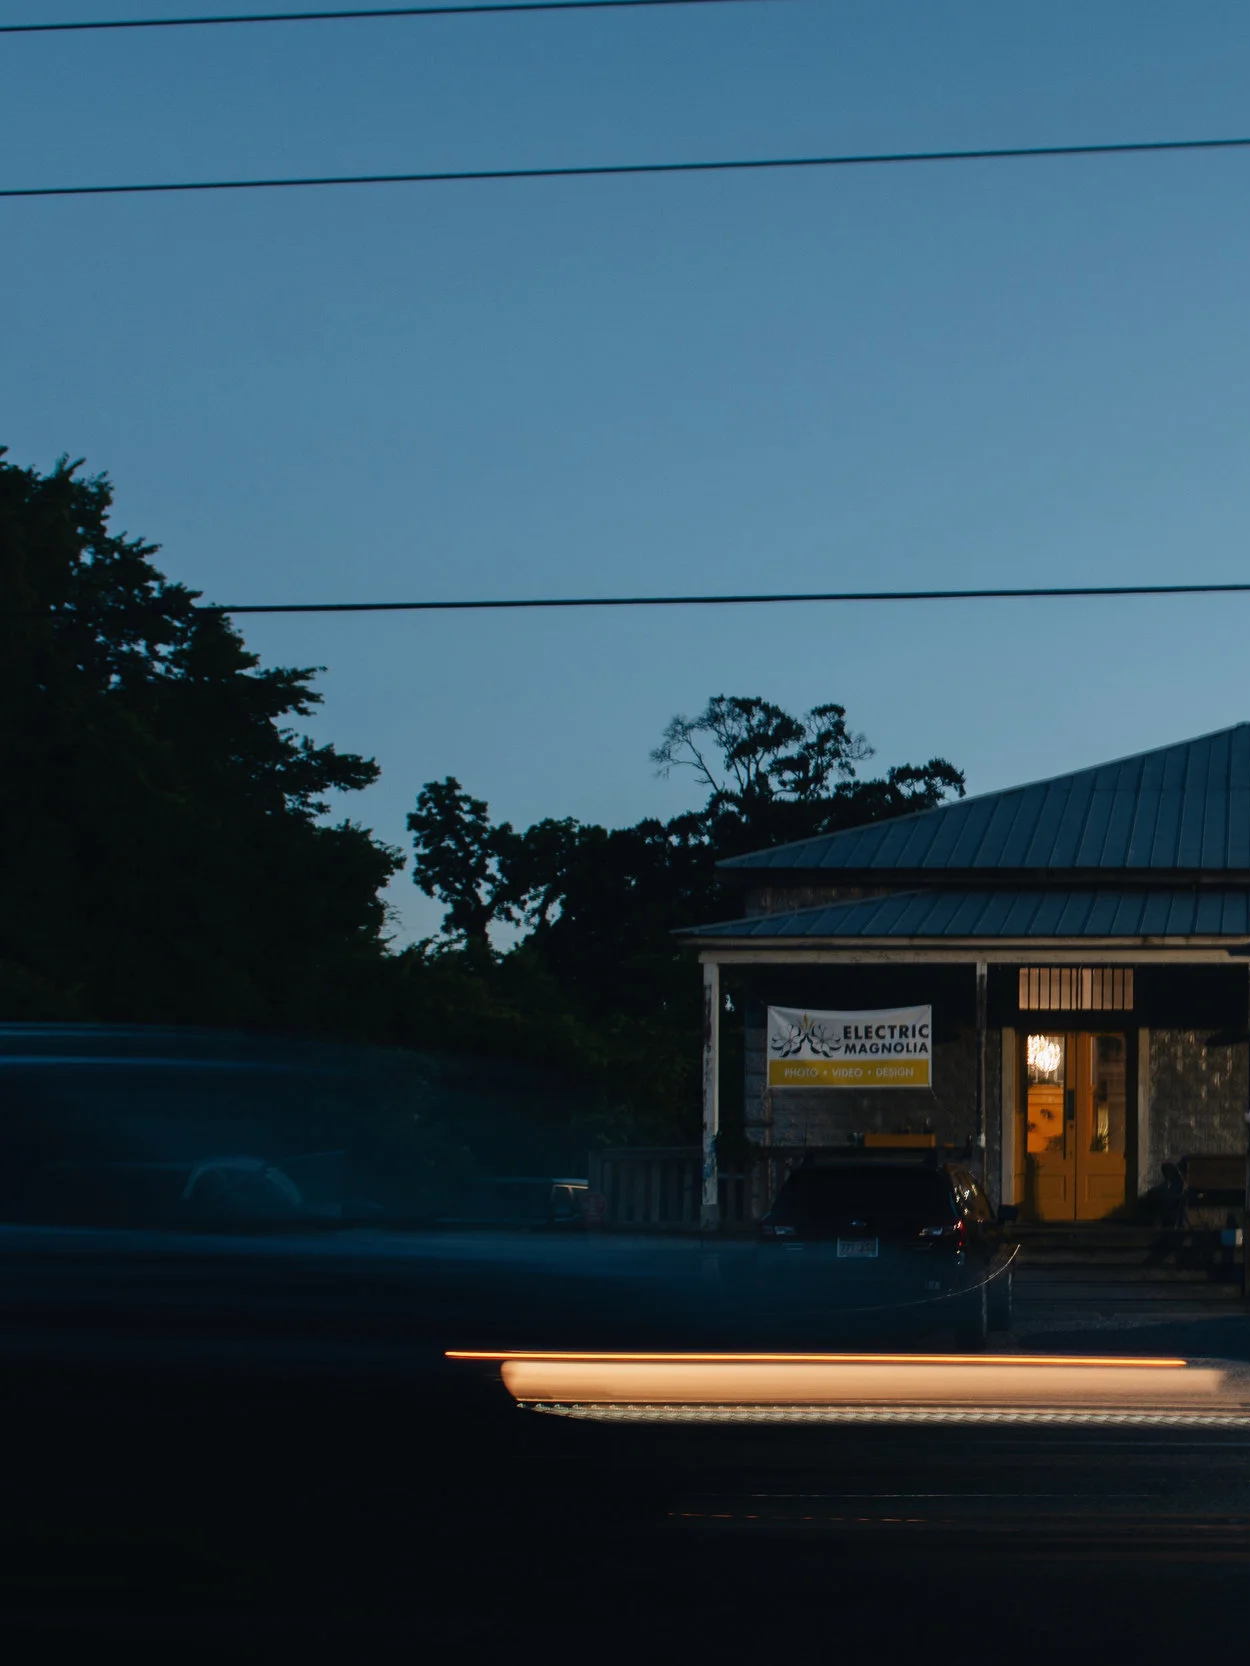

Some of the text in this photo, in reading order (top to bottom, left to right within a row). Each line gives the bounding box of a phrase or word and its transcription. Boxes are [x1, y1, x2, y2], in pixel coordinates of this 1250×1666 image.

[843, 1024, 930, 1040] ELECTRIC
[844, 1041, 929, 1055] MAGNOLIA
[784, 1067, 914, 1079] PHOTO VIDEO DESIGN
